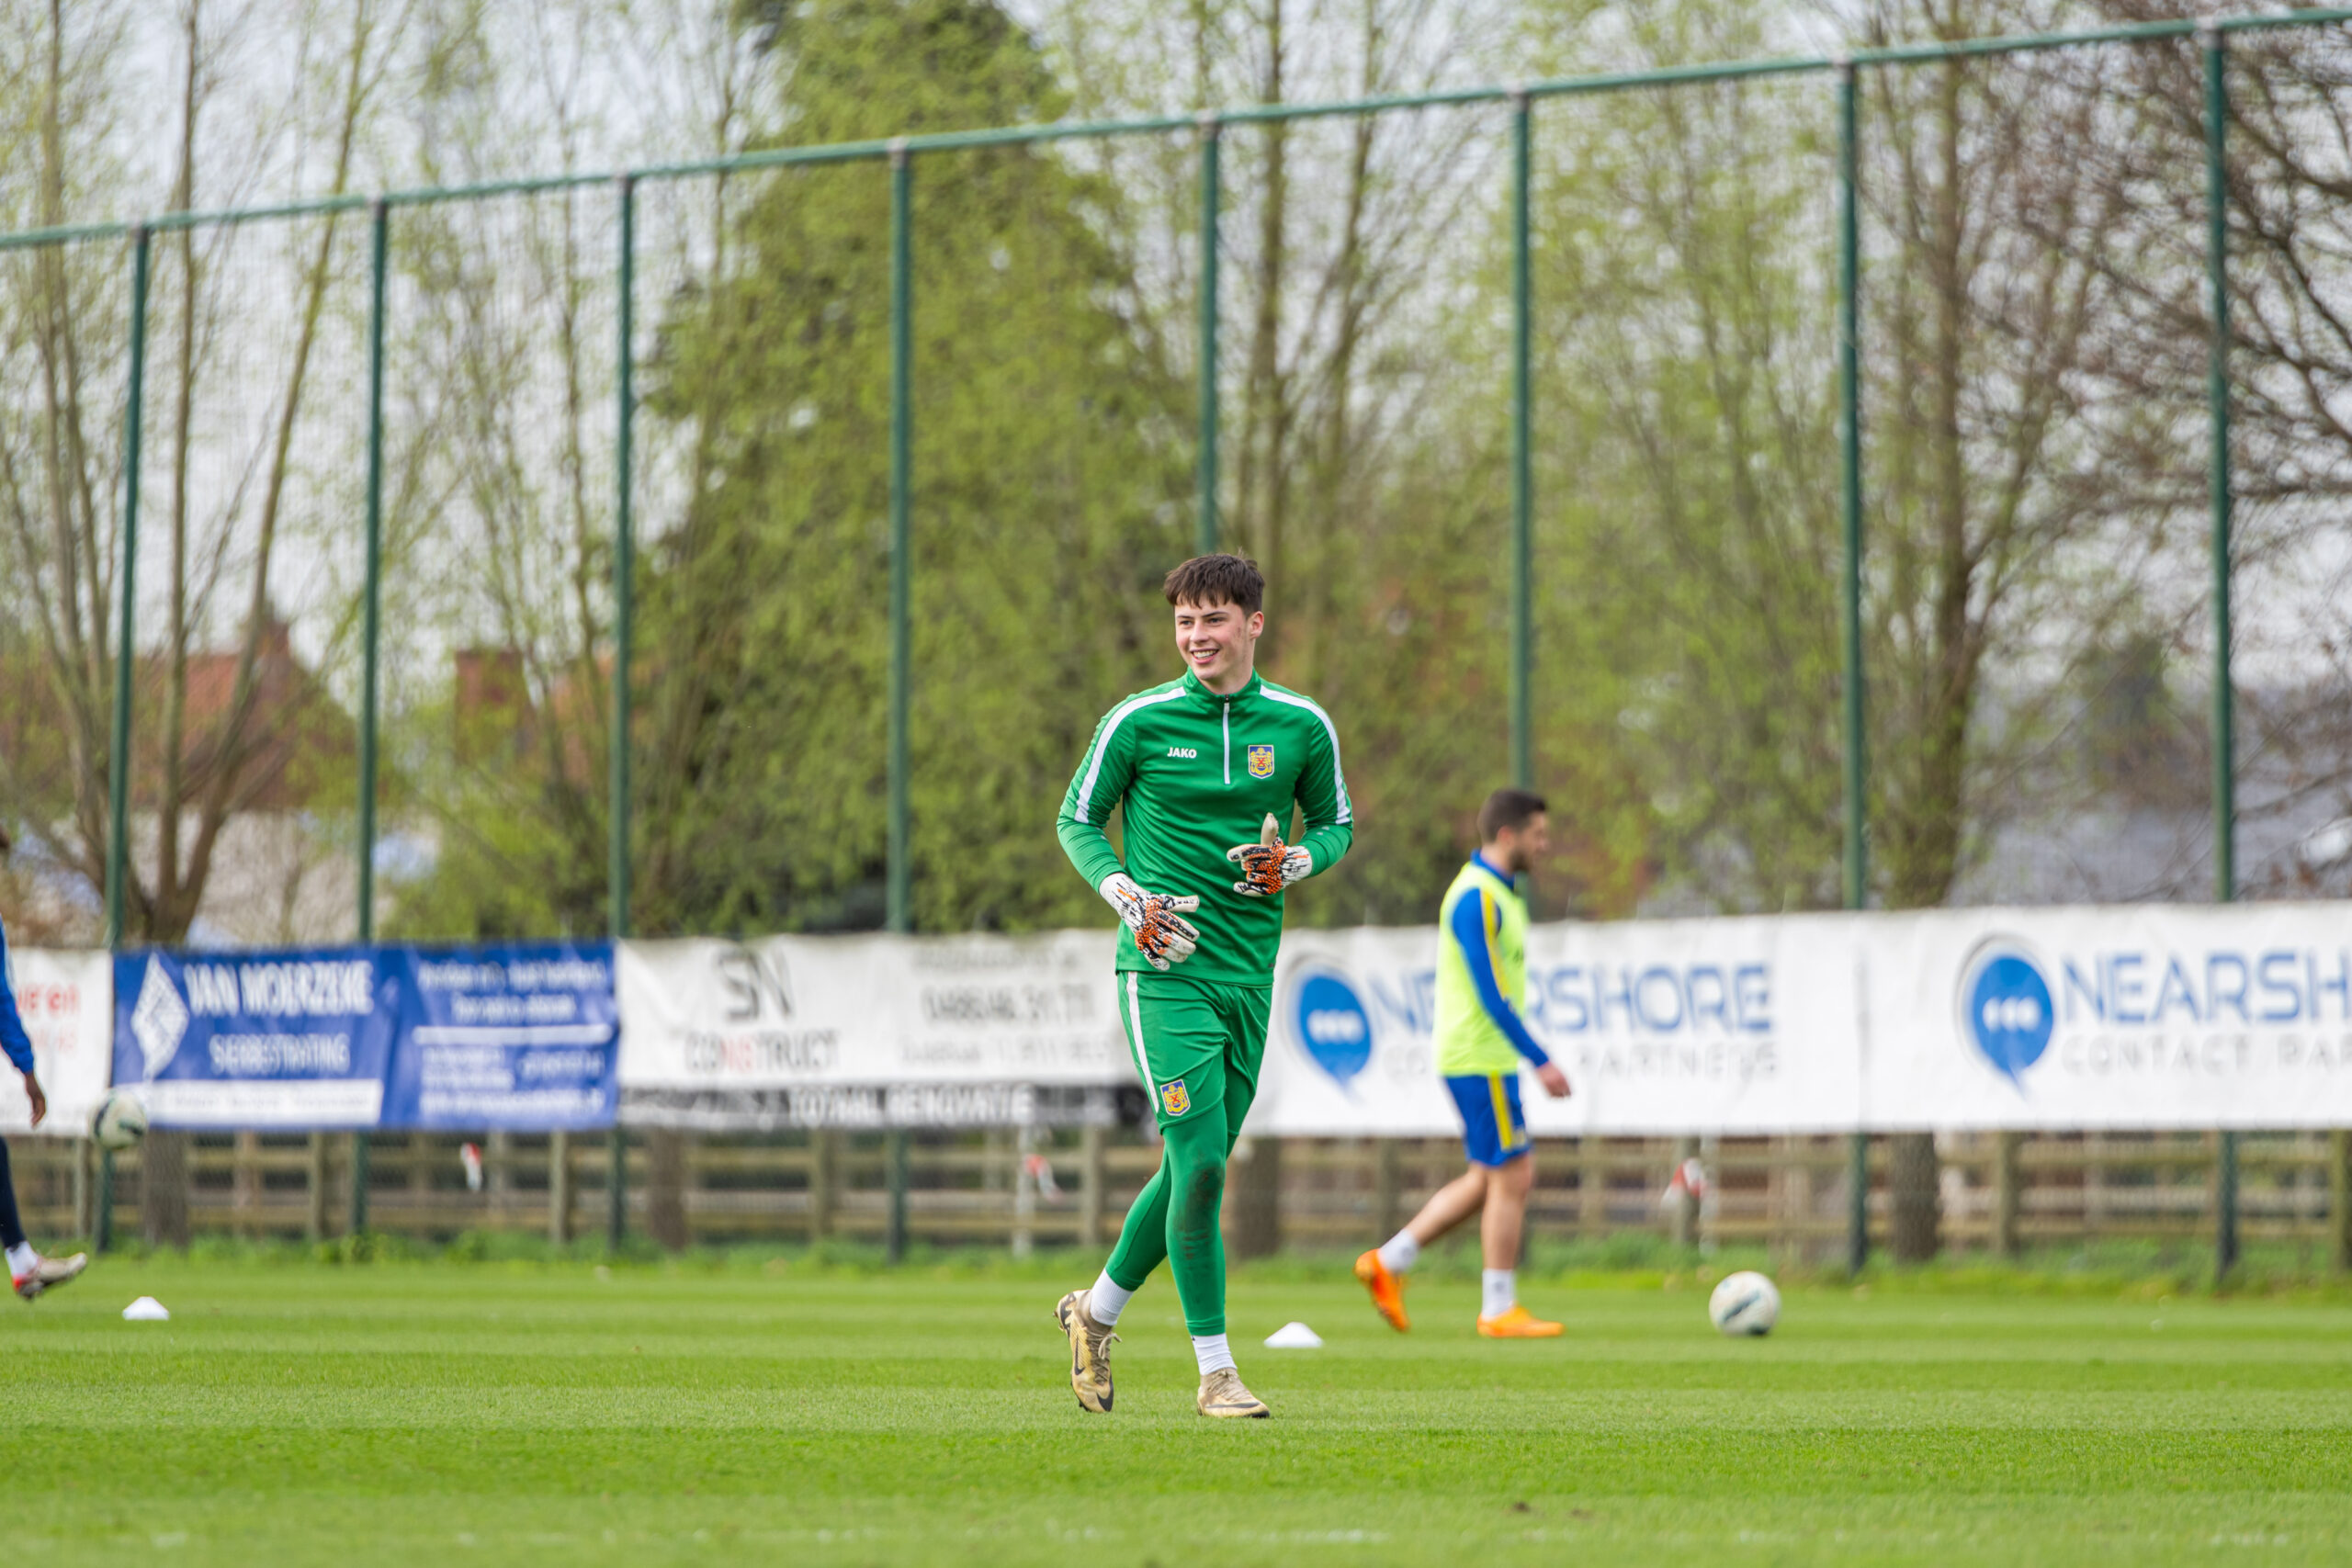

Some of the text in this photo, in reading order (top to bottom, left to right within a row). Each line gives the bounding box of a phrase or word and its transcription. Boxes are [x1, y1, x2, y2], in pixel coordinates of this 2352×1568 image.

[1167, 746, 1197, 759] JAKO
[185, 964, 239, 1017] VAN
[2062, 950, 2352, 1022] NEARSH
[685, 1029, 842, 1074] CONSTRUCT
[2062, 1034, 2250, 1075] CONTACT
